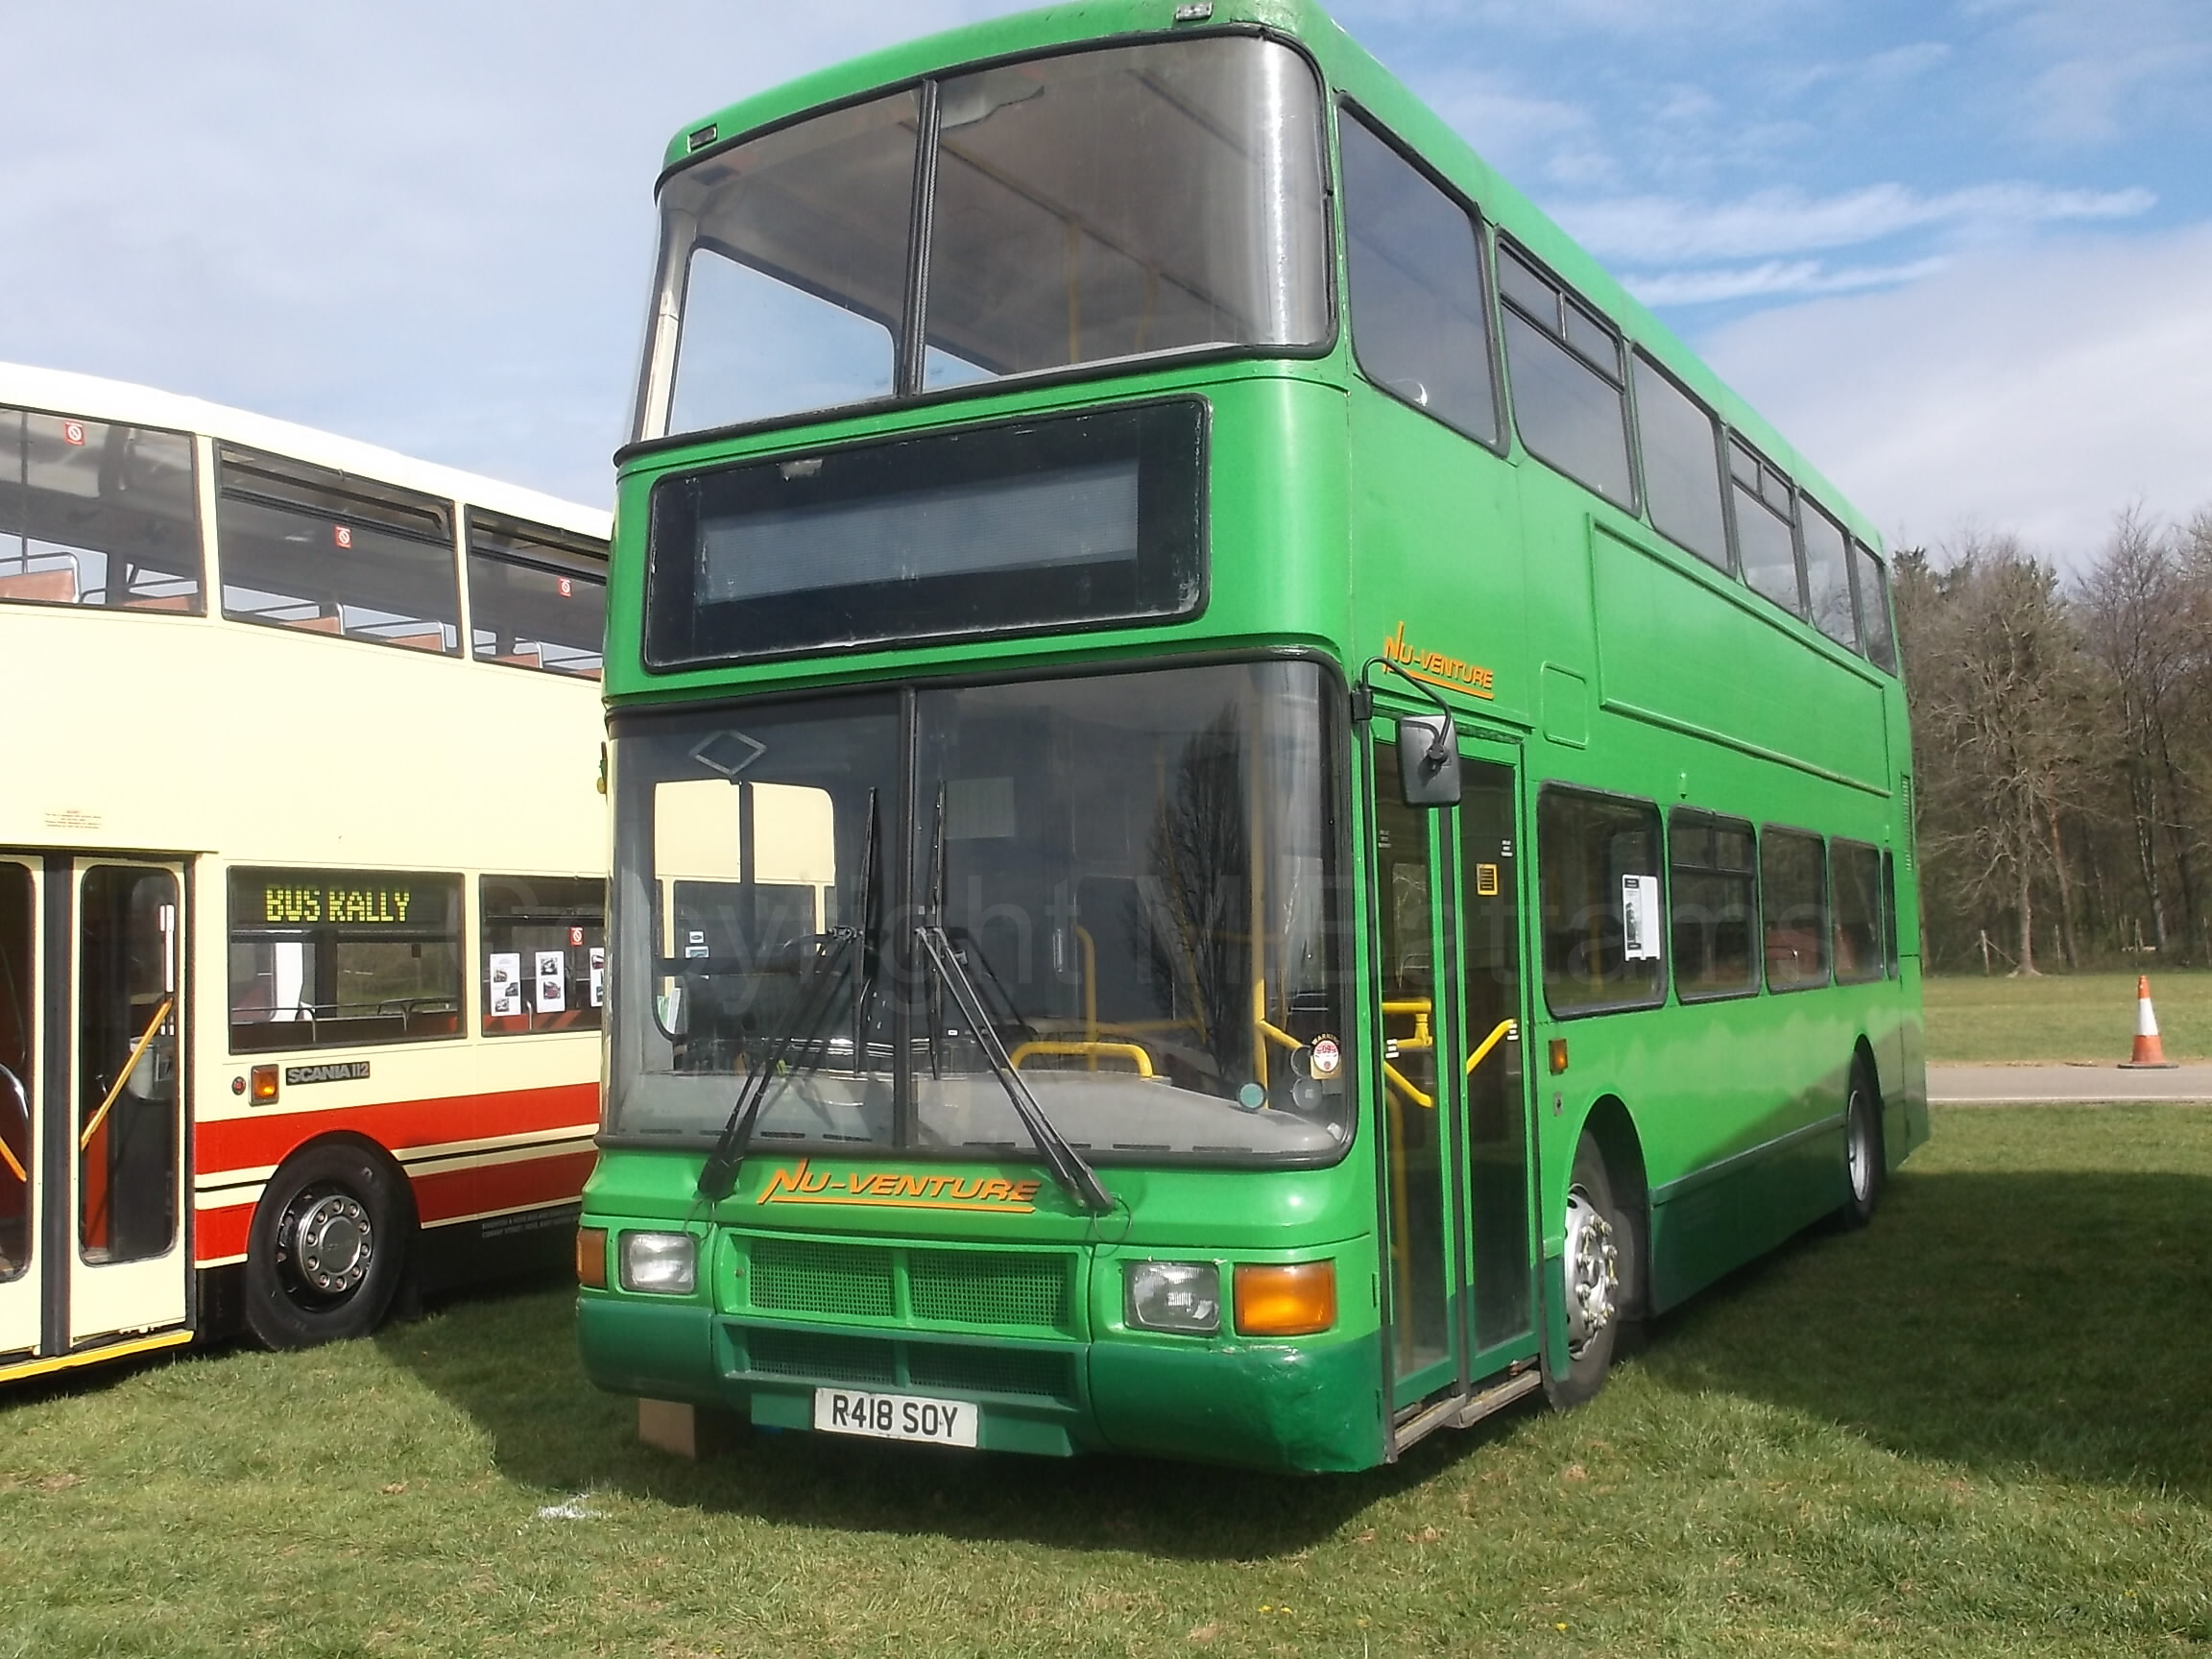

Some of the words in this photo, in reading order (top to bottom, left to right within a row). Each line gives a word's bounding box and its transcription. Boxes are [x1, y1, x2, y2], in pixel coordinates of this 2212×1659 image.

[266, 884, 321, 922] BUS
[328, 885, 411, 922] RALLY
[288, 1064, 351, 1083] SCANIA
[352, 1062, 370, 1077] 112
[831, 1394, 894, 1431] R418
[902, 1402, 958, 1438] SOY
